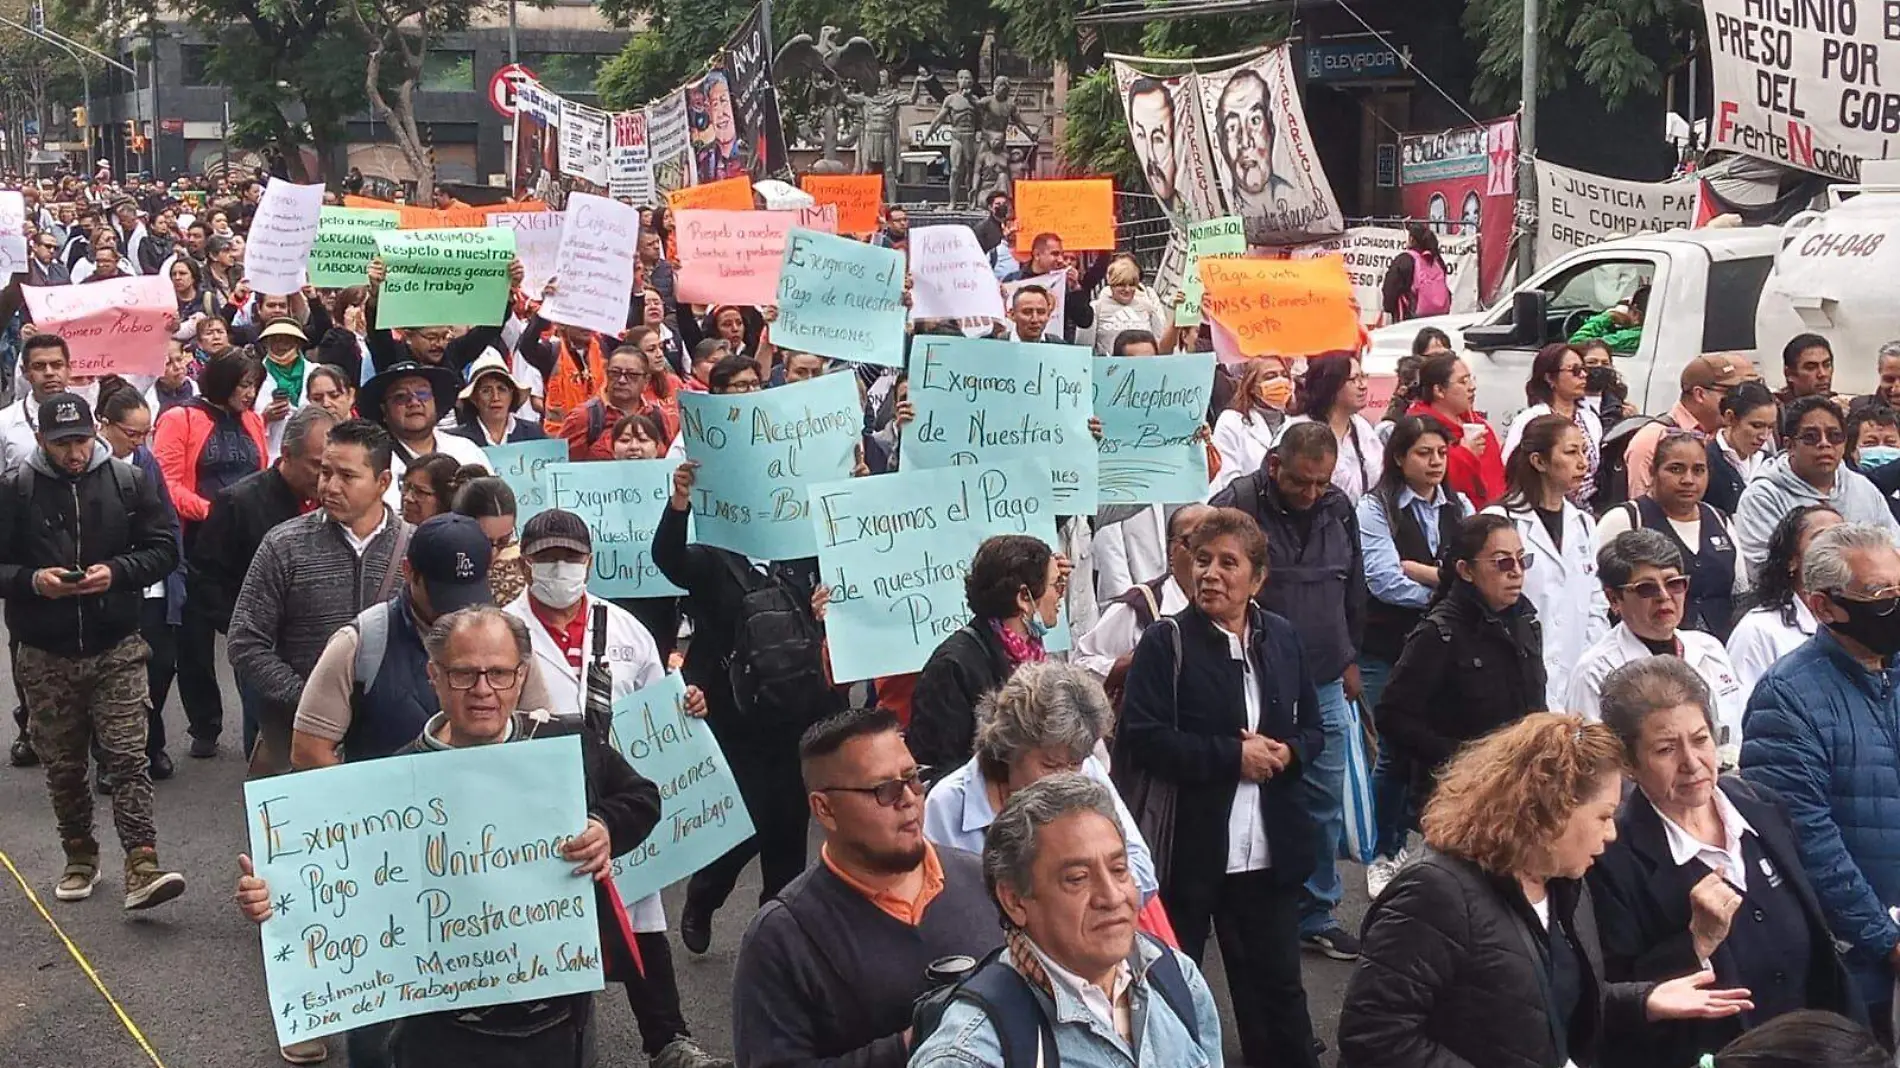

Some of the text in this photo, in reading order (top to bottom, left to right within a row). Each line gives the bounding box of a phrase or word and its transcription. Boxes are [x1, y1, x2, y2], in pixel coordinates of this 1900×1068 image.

[1716, 12, 1881, 86] PRESO POR
[1757, 69, 1805, 118] DEL
[1552, 197, 1574, 219] EL
[444, 248, 452, 256] a
[1801, 233, 1885, 257] CH-048
[384, 279, 401, 292] les
[404, 279, 418, 291] de
[923, 343, 1017, 403] Exigimos
[1024, 362, 1042, 396] el
[917, 410, 947, 443] de
[550, 472, 642, 517] Exigimos
[821, 469, 1039, 553] Exigimos el Pago
[829, 566, 864, 604] de
[258, 796, 449, 870] Exigimos
[667, 793, 735, 844] Trabajo
[300, 863, 359, 918] Pago
[374, 851, 409, 887] de
[301, 888, 585, 974] Pago de Prestaciones
[416, 942, 519, 975] Mensual
